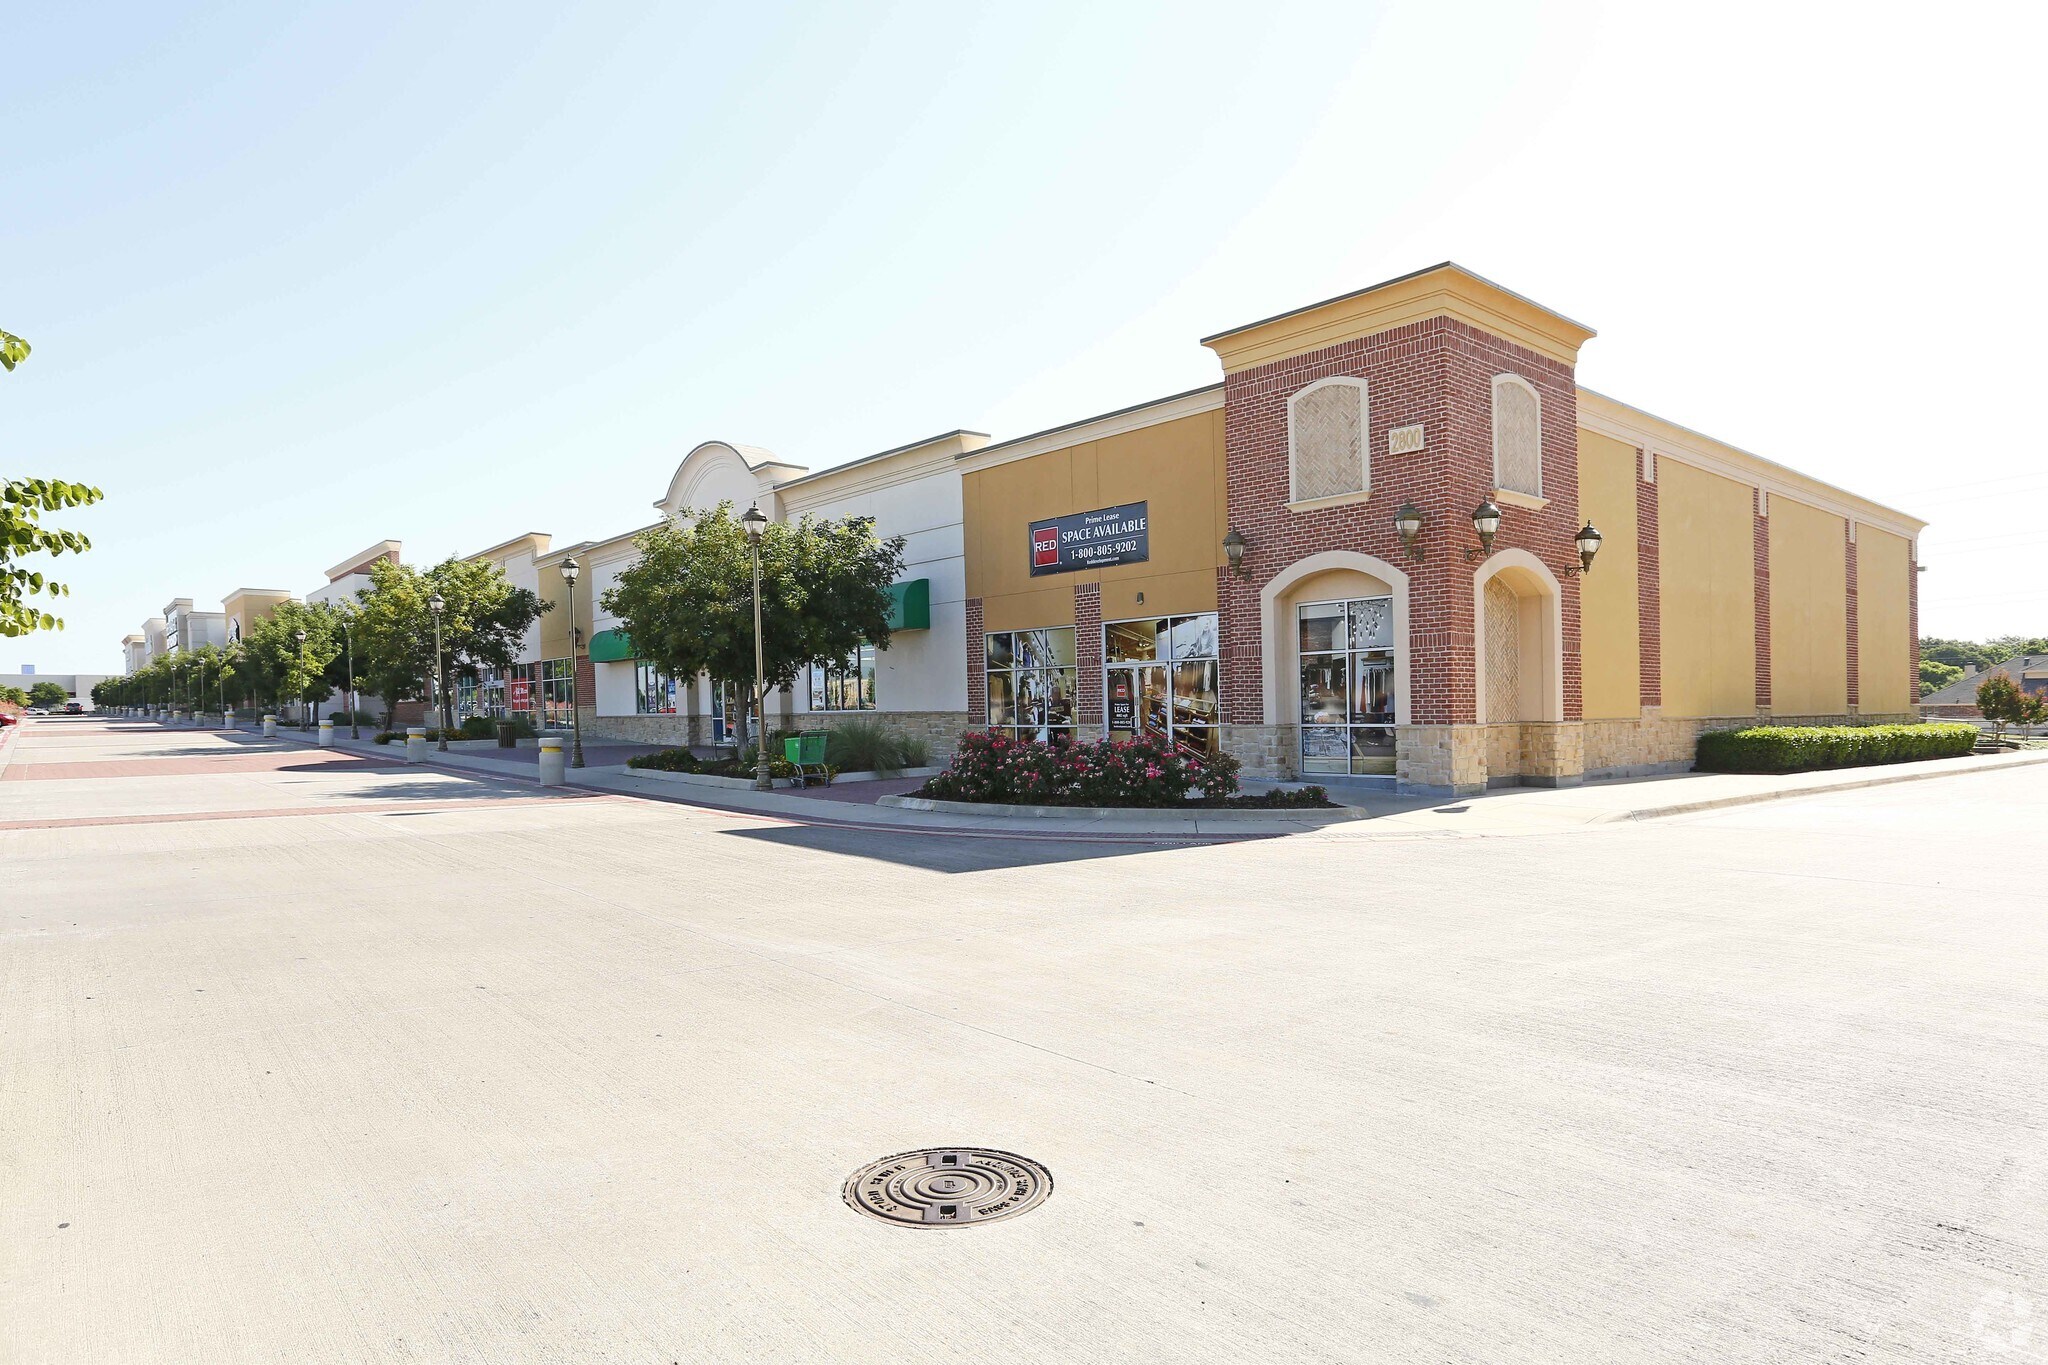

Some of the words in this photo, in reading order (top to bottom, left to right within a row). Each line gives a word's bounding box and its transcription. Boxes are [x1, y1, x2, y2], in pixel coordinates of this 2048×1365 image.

[1391, 428, 1421, 453] 2800
[1085, 516, 1102, 525] Prime
[1103, 512, 1120, 522] Lease
[1062, 527, 1091, 544] SPACE
[1093, 517, 1146, 538] AVAILABLE
[1035, 539, 1057, 553] RED
[1070, 540, 1137, 560] 1-800-805-9202
